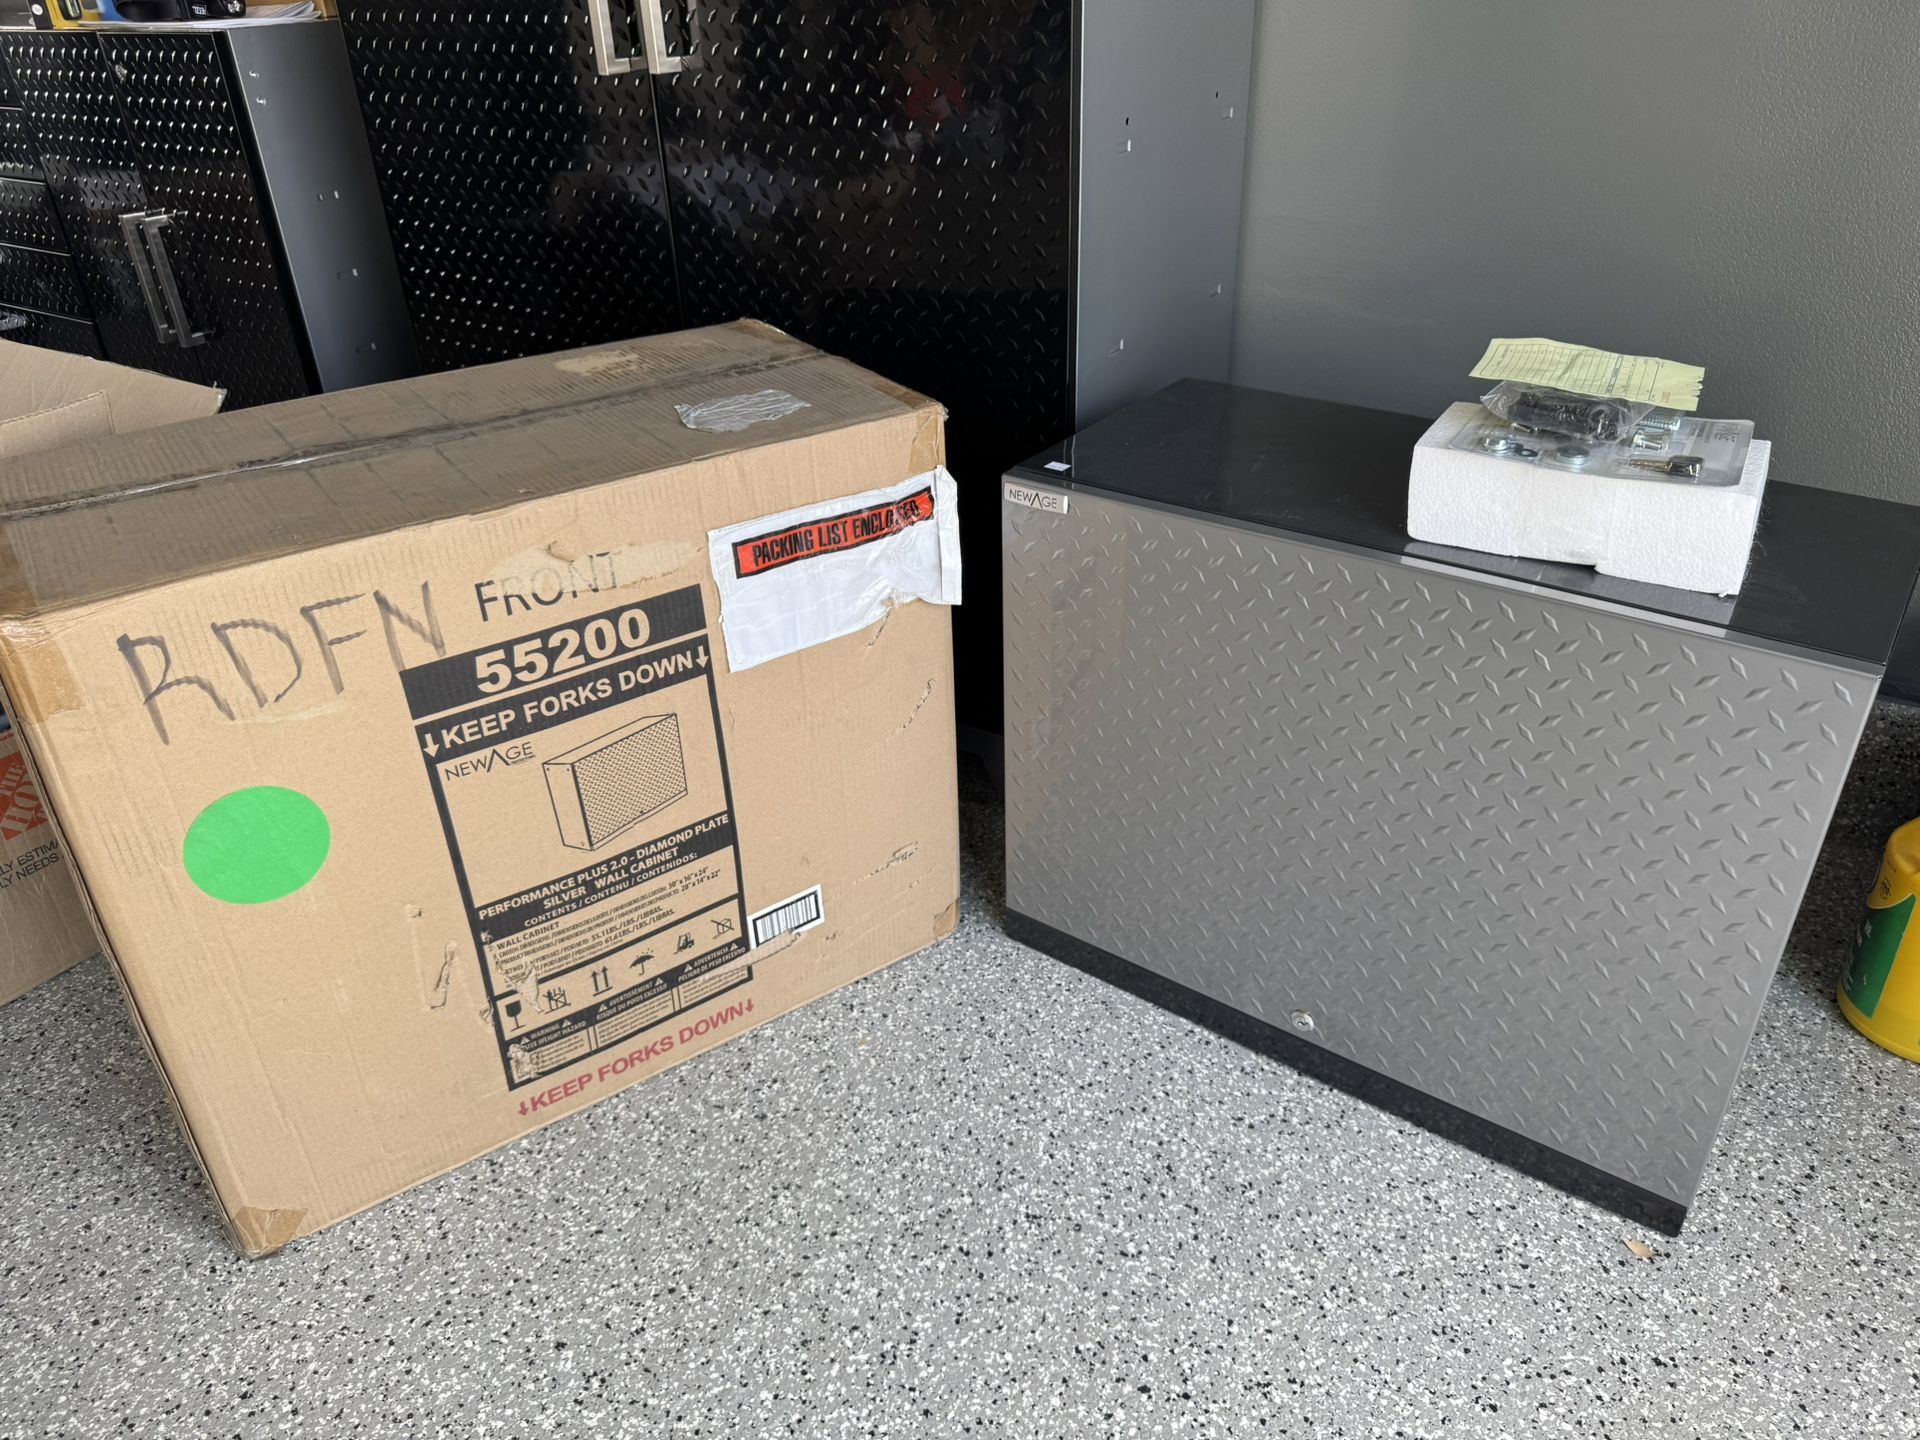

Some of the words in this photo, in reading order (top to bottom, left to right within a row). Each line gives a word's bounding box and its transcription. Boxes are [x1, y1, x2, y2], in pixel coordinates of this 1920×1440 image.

[1009, 489, 1058, 509] NEWAGE
[751, 530, 815, 567] PACKING
[817, 521, 850, 549] LIST
[474, 551, 621, 622] FRONT
[474, 607, 651, 694] 55200
[440, 708, 517, 750] KEEP
[523, 677, 613, 723] FORKS
[619, 648, 695, 692] DOWN
[445, 742, 534, 781] NEWAGE
[0, 859, 13, 876] LY
[15, 852, 59, 880] NEEDS
[478, 875, 575, 921] PERFORMANCE
[577, 863, 608, 883] PLUS
[609, 855, 628, 870] 2.0
[635, 828, 693, 859] DIAMOND
[694, 813, 728, 834] PLATE
[524, 901, 576, 928] CONTENTS
[584, 880, 629, 904] CONTENU
[636, 851, 697, 882] CONTENIDOS:
[543, 884, 586, 909] SILVER
[594, 867, 628, 889] WALL
[629, 846, 679, 874] CABINET
[497, 935, 520, 950] WALL
[522, 920, 559, 940] CABINET
[530, 1073, 594, 1112] KEEP
[597, 1034, 675, 1083] FORKS
[678, 1000, 745, 1046] DOWN
